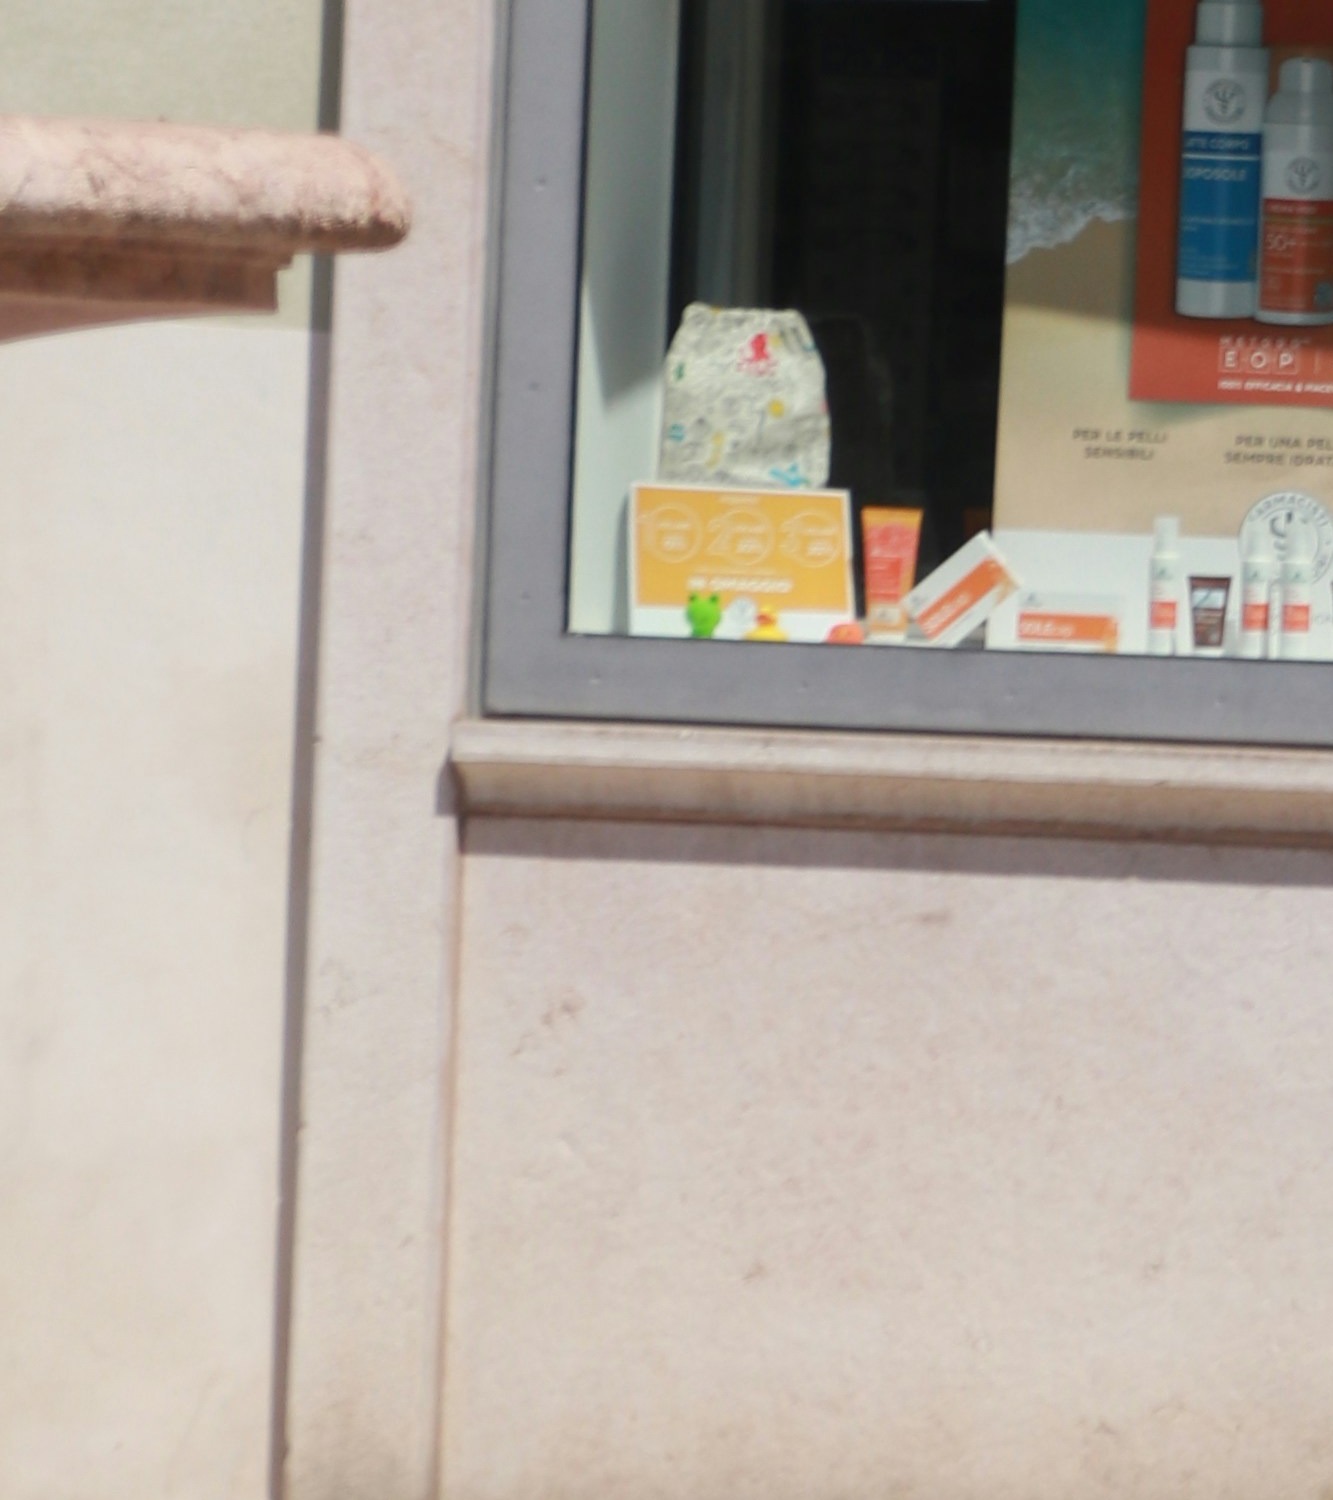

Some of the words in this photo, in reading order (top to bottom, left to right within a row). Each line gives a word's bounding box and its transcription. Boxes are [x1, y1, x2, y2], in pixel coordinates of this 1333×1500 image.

[1072, 428, 1099, 441] PER
[1107, 429, 1122, 442] LE
[1128, 429, 1168, 444] PELLI
[1235, 435, 1263, 448] PER
[1269, 436, 1301, 449] UNA
[1224, 451, 1284, 466] SEMPRE
